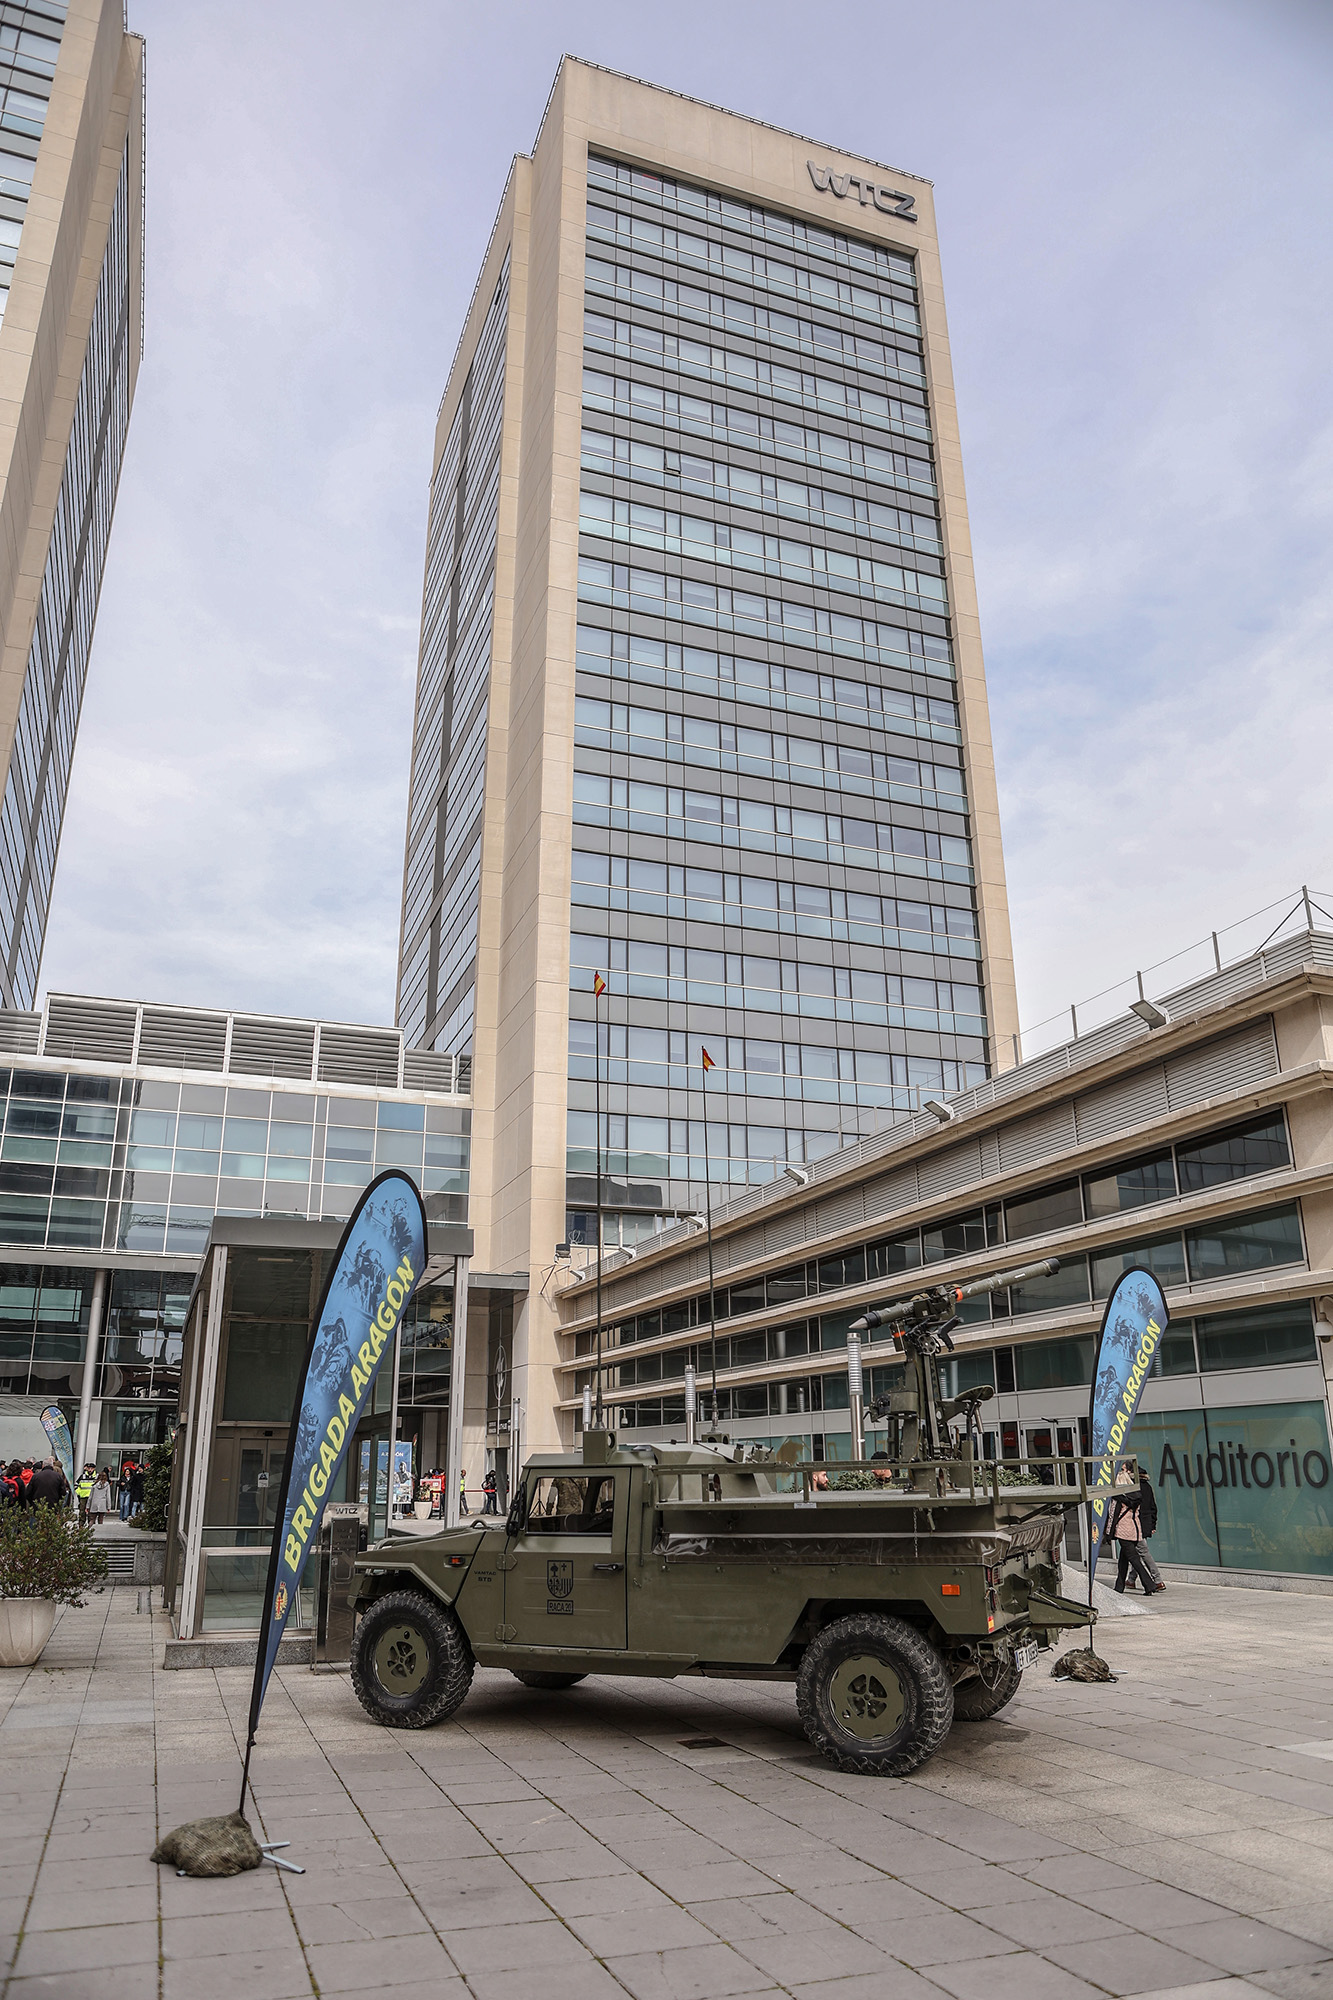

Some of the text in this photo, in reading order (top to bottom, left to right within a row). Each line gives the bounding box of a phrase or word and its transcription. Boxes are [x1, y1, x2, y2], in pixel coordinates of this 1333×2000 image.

[807, 160, 918, 222] WTCZ
[1122, 1317, 1161, 1412] ARAGÓN
[284, 1254, 415, 1573] BRIGADA ARAGÓN
[1158, 1438, 1329, 1489] Auditorio
[335, 1507, 358, 1515] WTCZ
